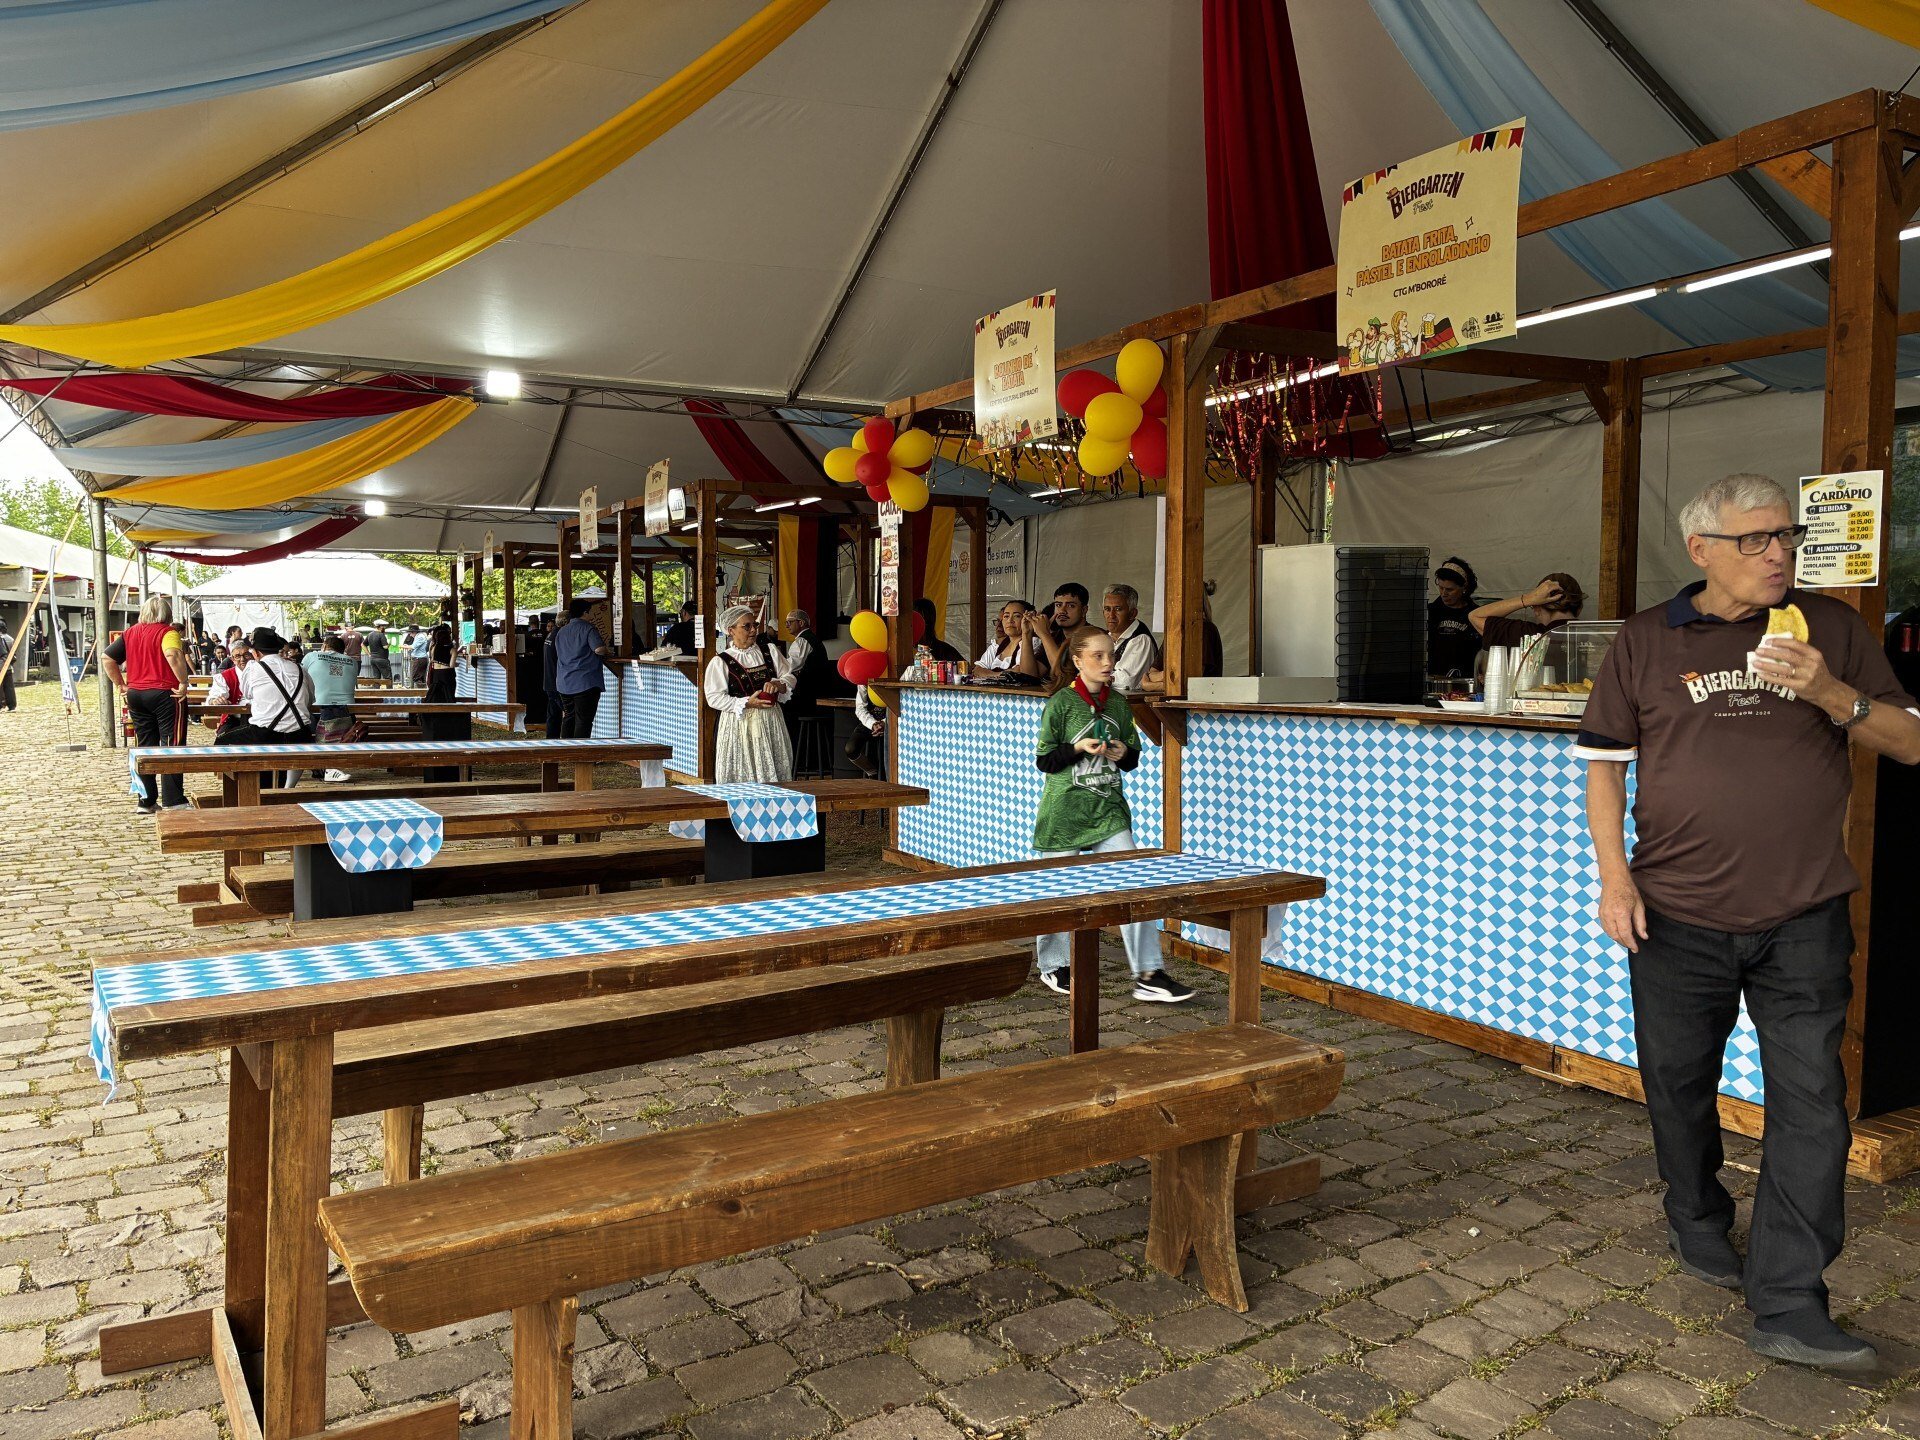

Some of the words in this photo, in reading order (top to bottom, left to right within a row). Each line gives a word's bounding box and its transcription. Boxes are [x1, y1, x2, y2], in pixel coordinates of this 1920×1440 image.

[1389, 171, 1465, 219] BIERGARTEN
[1412, 199, 1434, 215] Fest
[1382, 235, 1420, 262] BATATA
[1423, 224, 1458, 250] FRITA,
[1356, 262, 1394, 288] PASTEL
[1396, 258, 1405, 277] E
[1406, 233, 1491, 274] ENROLADINHO
[1393, 287, 1408, 298] CTG
[996, 320, 1031, 349] BIERGARTEN
[994, 356, 1022, 379] BOLINHO
[1023, 352, 1033, 369] DE
[1002, 370, 1025, 391] BATATA
[1809, 487, 1872, 503] CARDÁPIO
[1818, 504, 1847, 512] BEBIDAS
[1816, 544, 1857, 552] ALIMENTAÇÃO
[1854, 560, 1868, 568] 5,00
[1728, 693, 1761, 707] Fest
